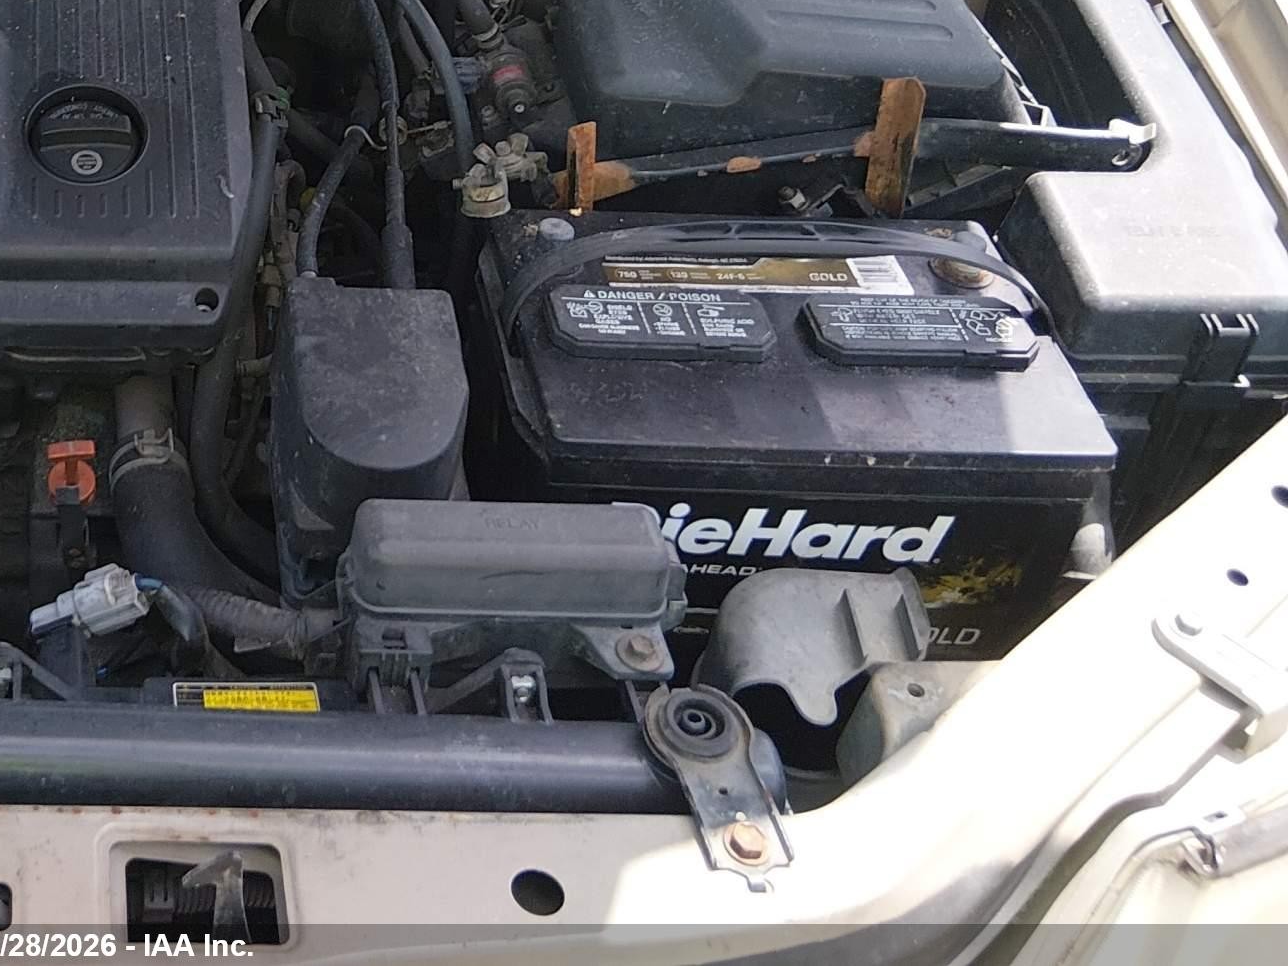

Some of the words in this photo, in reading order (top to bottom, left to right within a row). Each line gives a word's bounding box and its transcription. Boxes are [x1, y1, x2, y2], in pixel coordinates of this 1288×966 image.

[808, 272, 848, 282] GOLD
[597, 290, 655, 301] DANGER
[668, 292, 721, 302] POISON
[659, 503, 956, 563] ieHard
